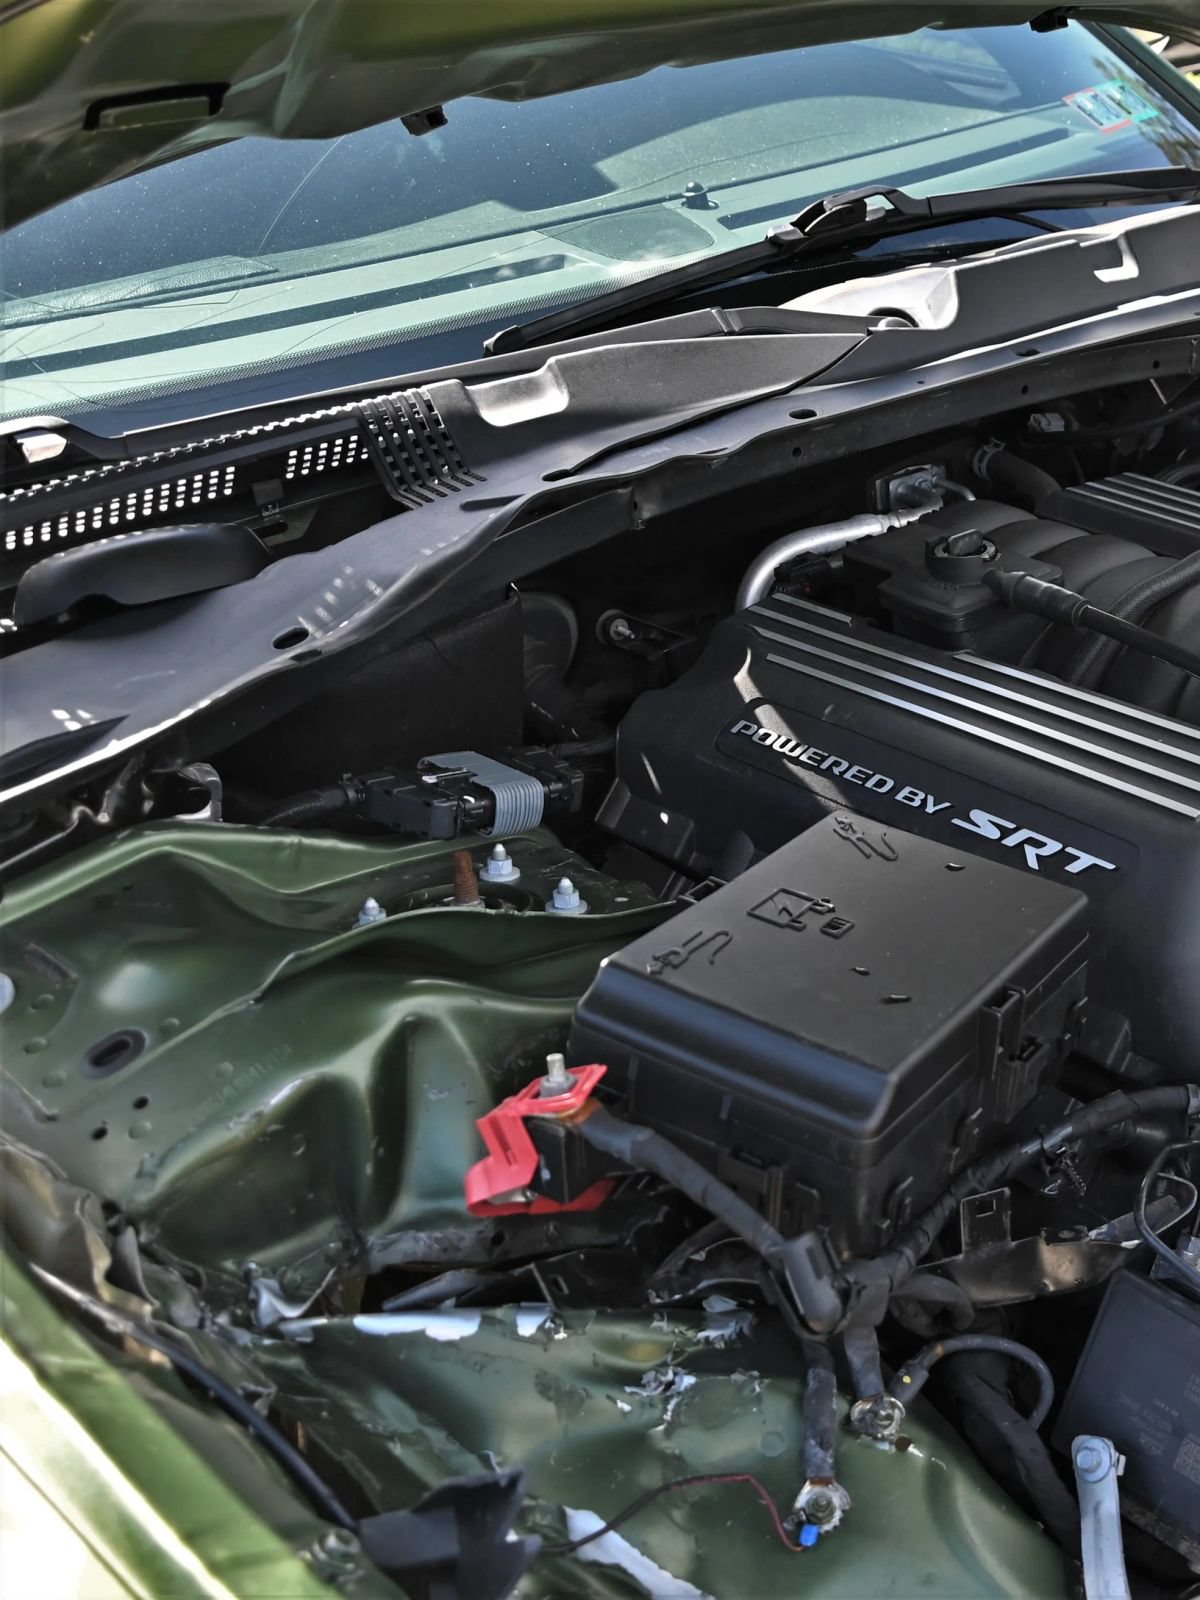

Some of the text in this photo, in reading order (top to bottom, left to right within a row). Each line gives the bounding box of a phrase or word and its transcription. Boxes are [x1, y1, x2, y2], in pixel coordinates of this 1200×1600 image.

[730, 719, 1116, 874] POWERED BY SRT
